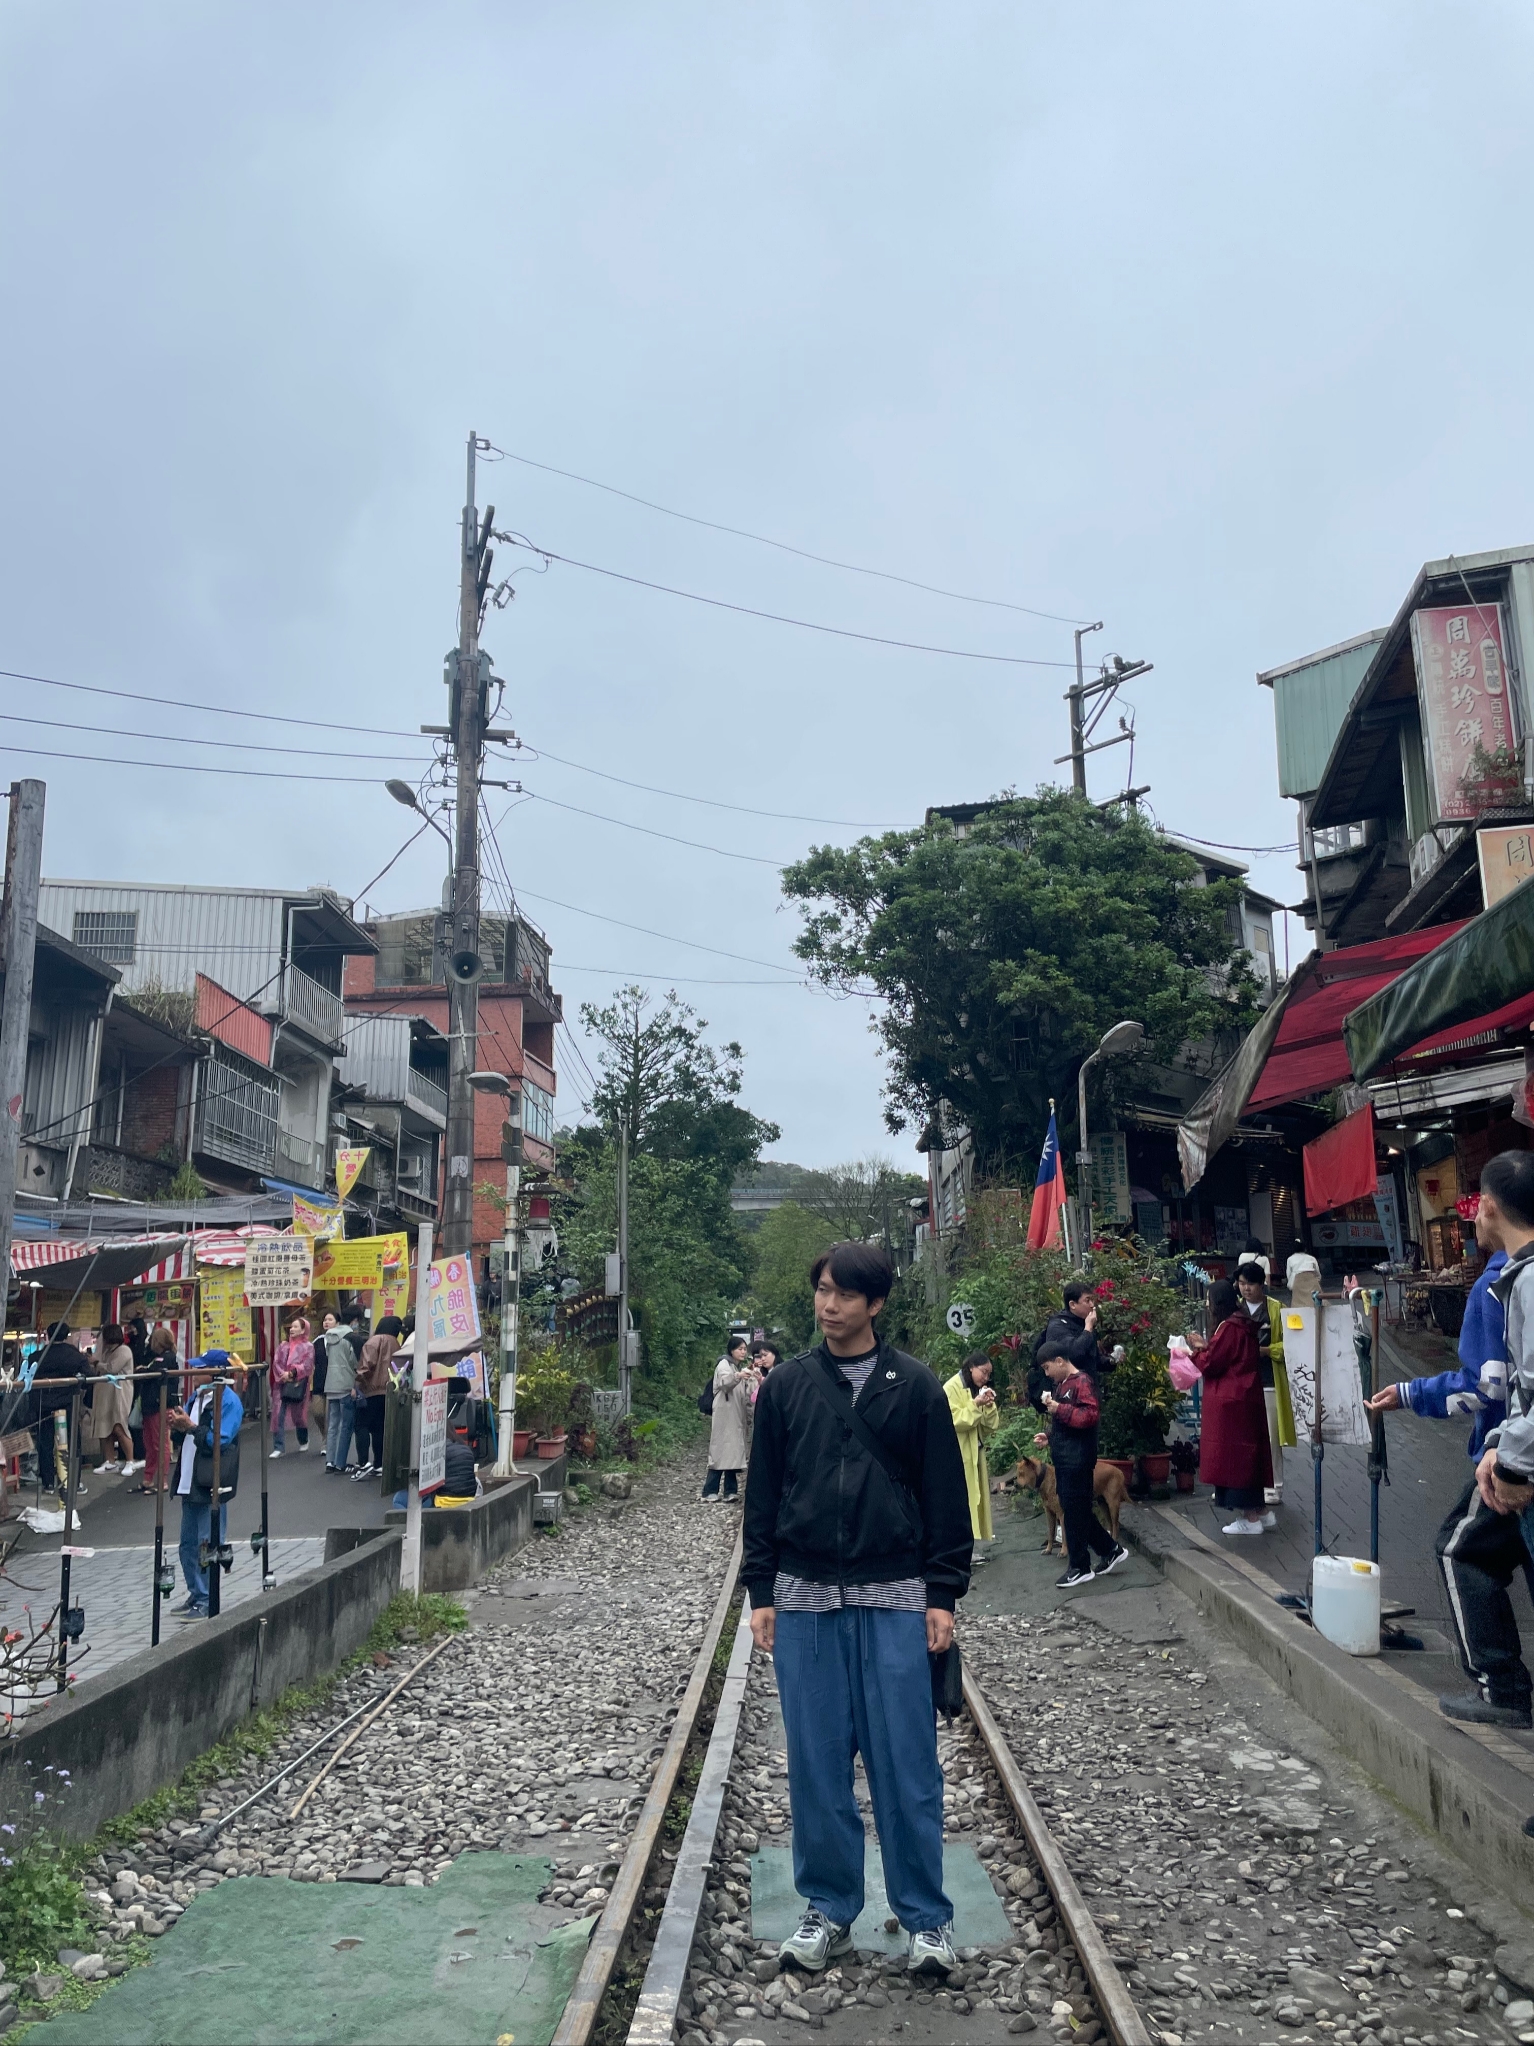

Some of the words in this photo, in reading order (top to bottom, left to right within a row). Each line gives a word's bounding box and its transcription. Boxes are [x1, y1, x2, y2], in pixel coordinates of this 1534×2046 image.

[257, 1242, 303, 1253] 冷熱飲品
[250, 1278, 299, 1288] 冷/熱珍珠奶茶
[321, 1276, 378, 1286] 十分營養三明治
[951, 1308, 975, 1328] 35
